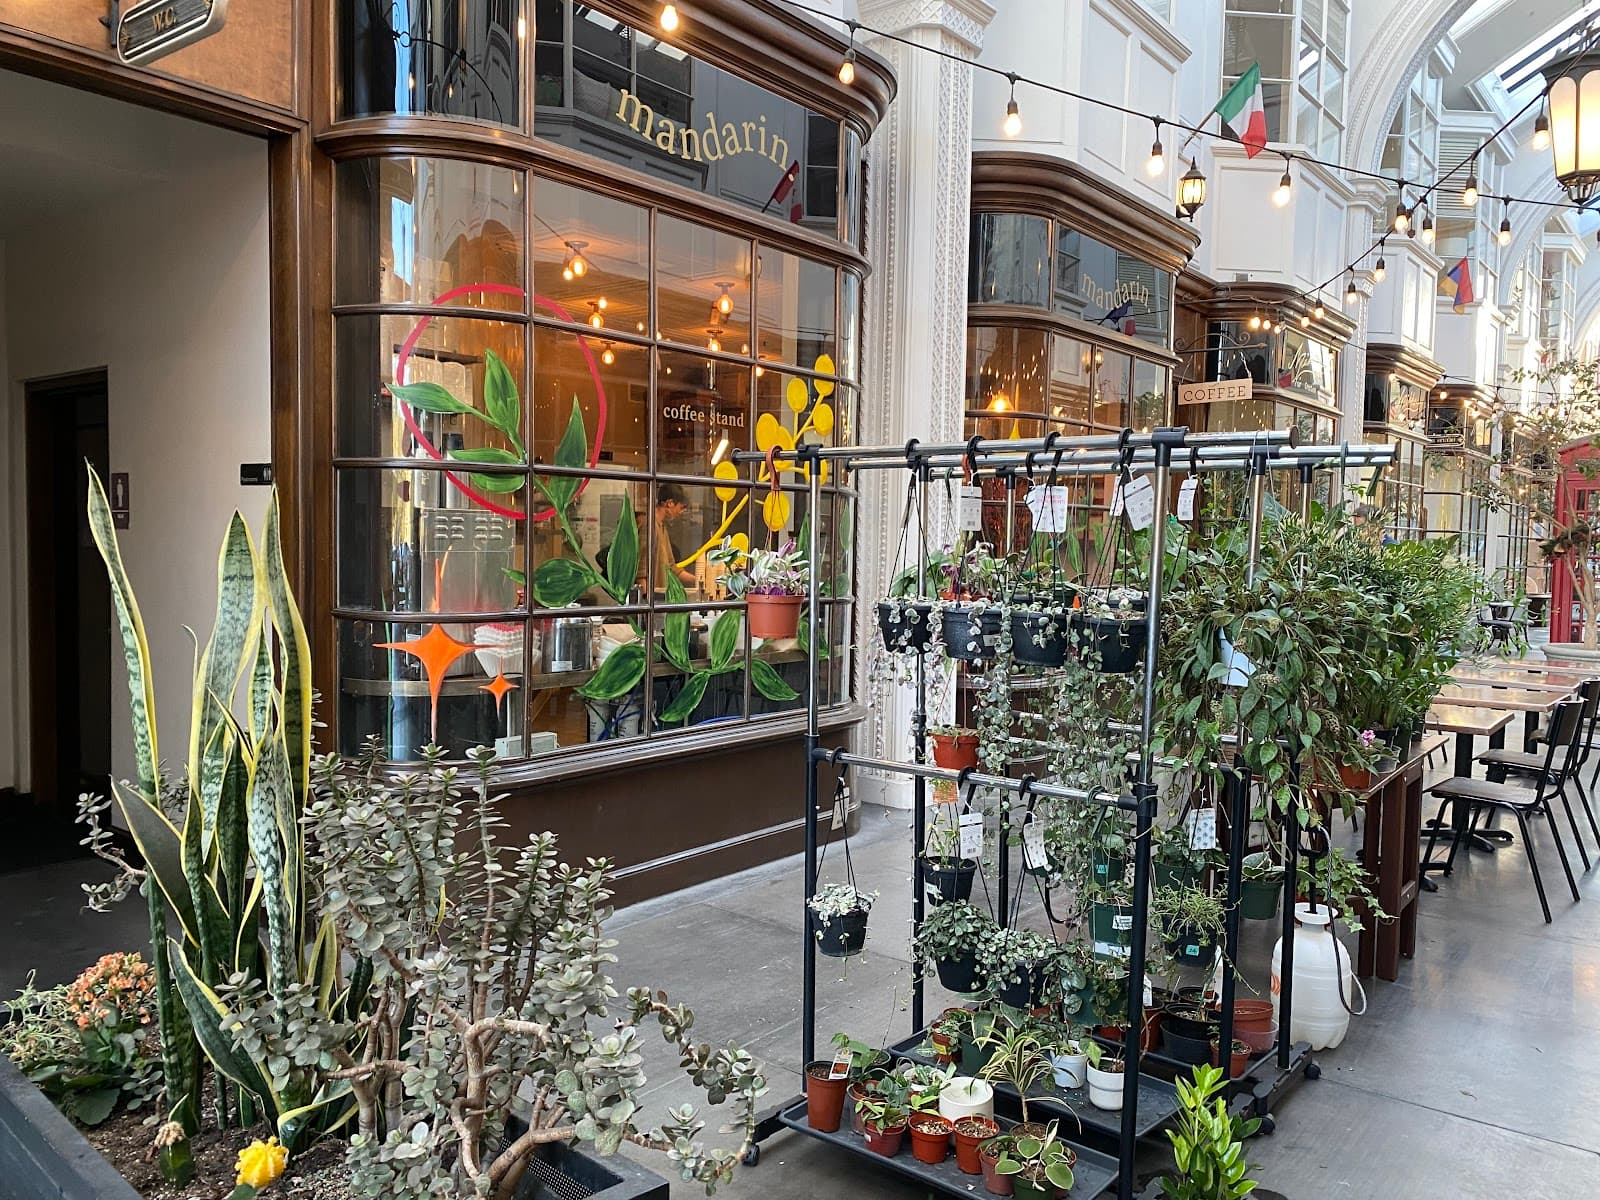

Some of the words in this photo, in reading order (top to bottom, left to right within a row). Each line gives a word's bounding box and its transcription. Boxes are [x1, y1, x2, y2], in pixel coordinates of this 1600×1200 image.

[1183, 385, 1246, 402] COFFEE
[663, 403, 705, 423] coffee
[709, 410, 745, 428] stand
